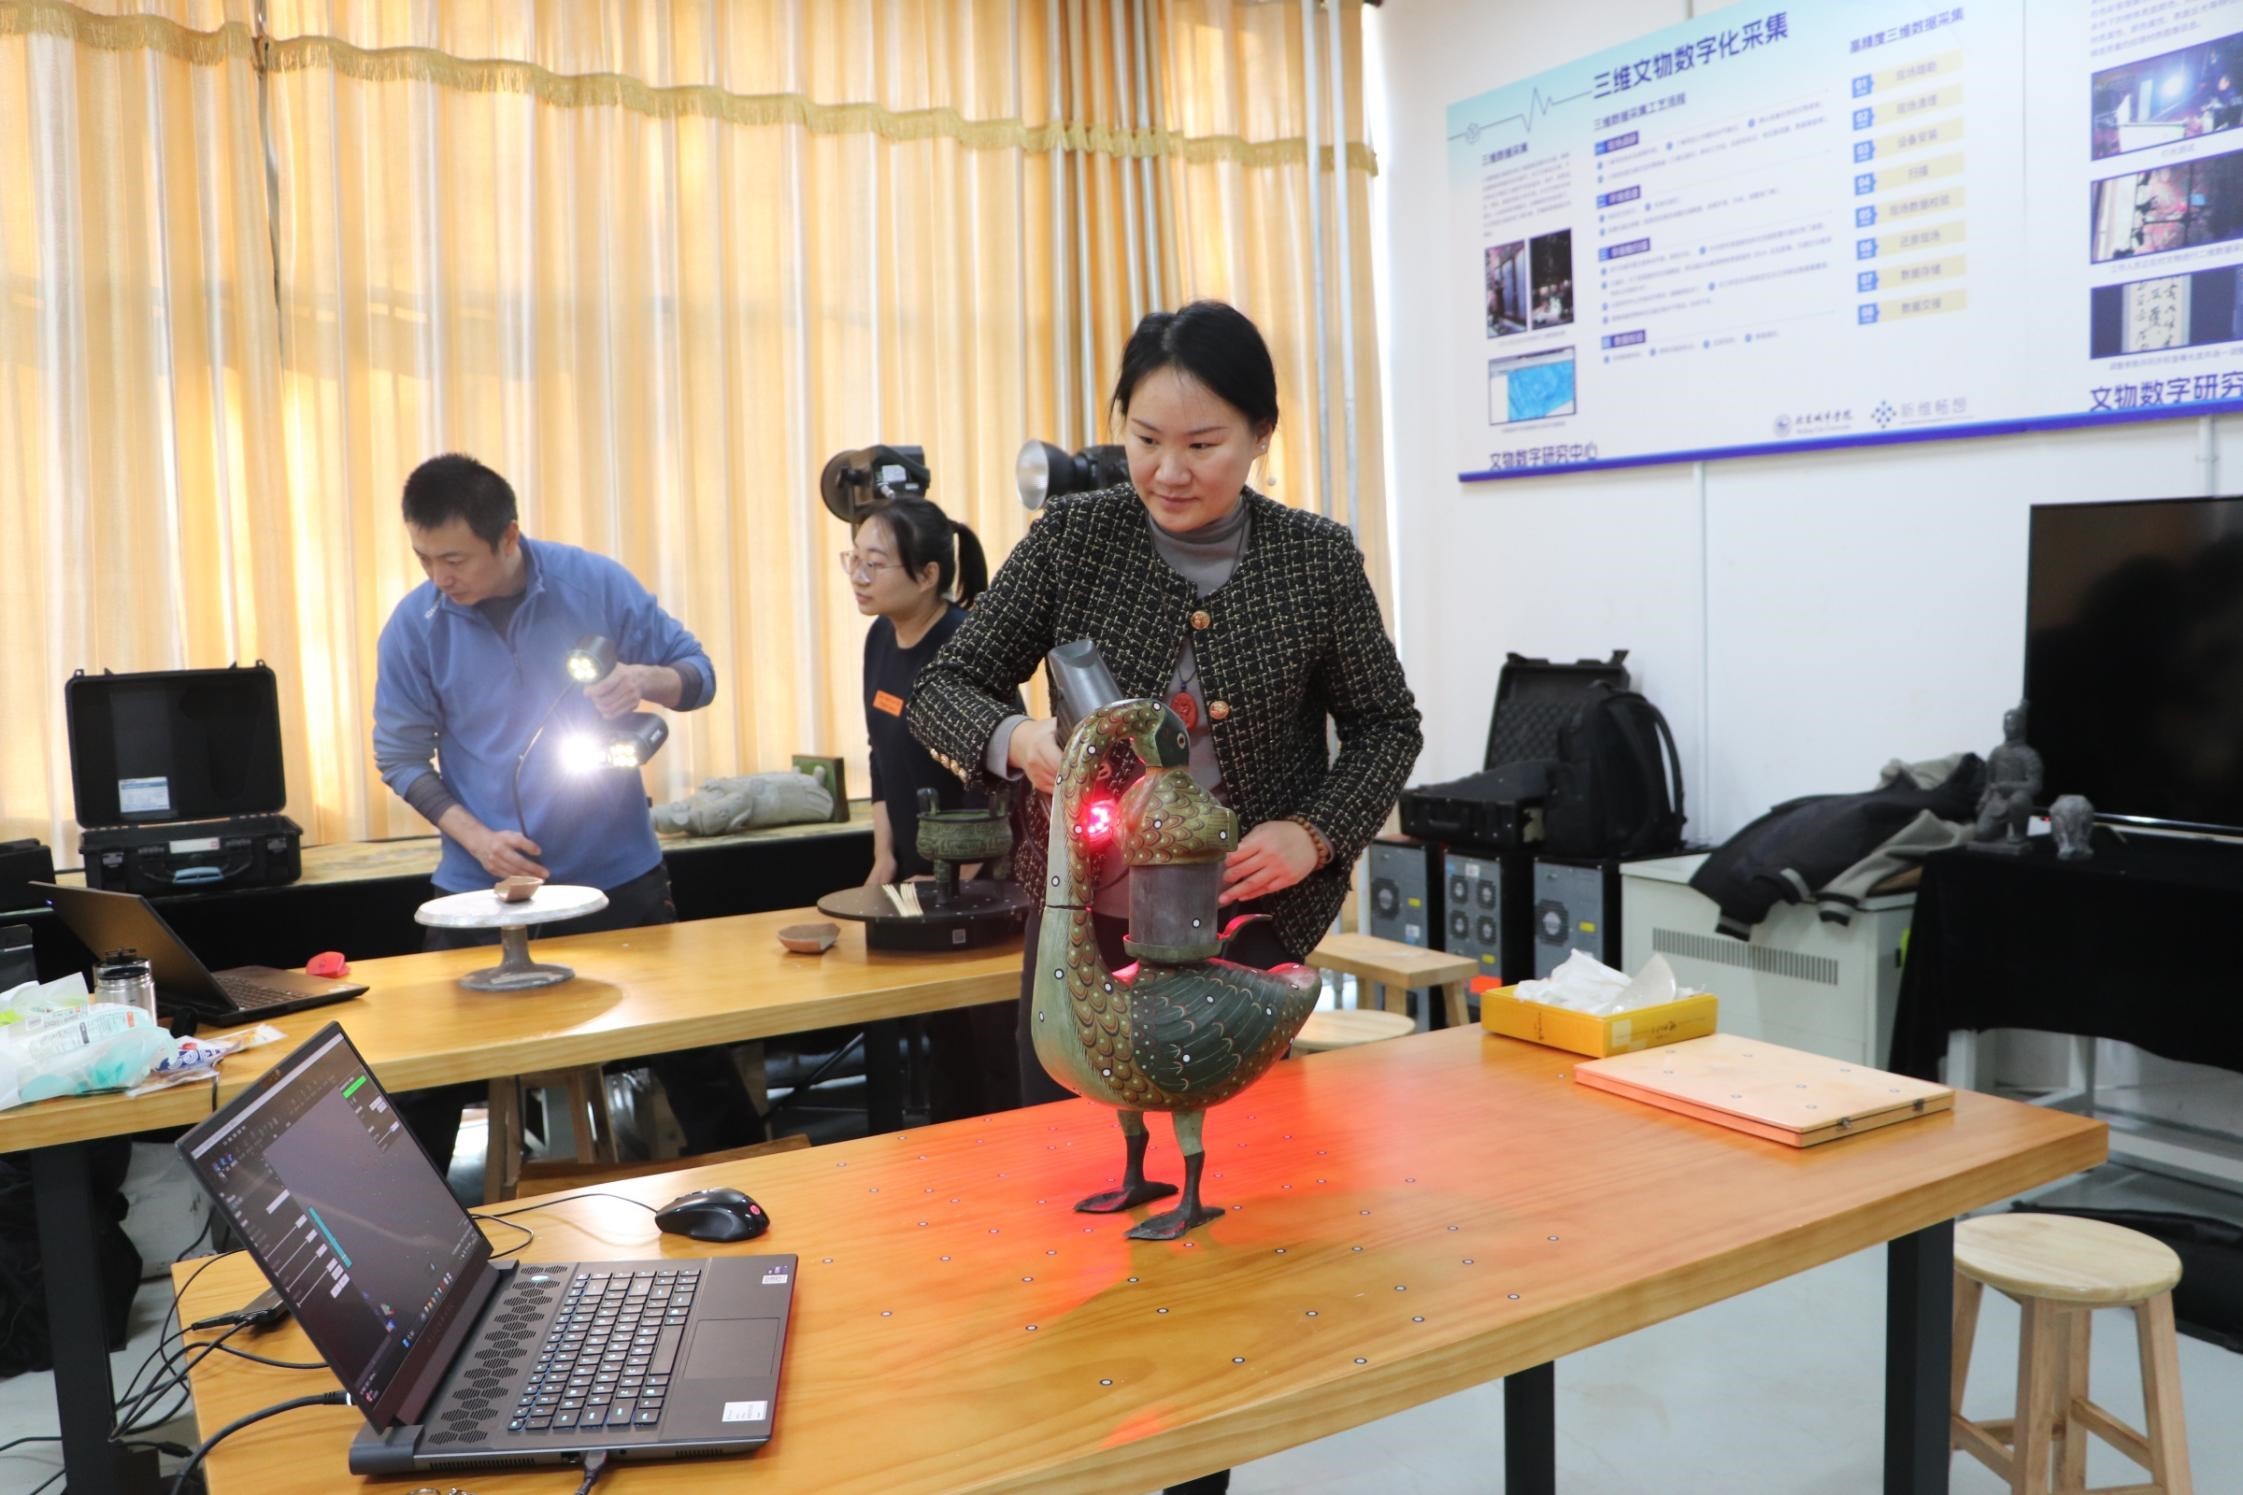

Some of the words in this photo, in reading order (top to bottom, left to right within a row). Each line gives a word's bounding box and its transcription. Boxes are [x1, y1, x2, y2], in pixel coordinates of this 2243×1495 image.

[1593, 12, 1788, 98] 三维文物数字化采集
[2089, 371, 2243, 412] 文物数字研究
[1489, 441, 1598, 471] 文物数字研究中心
